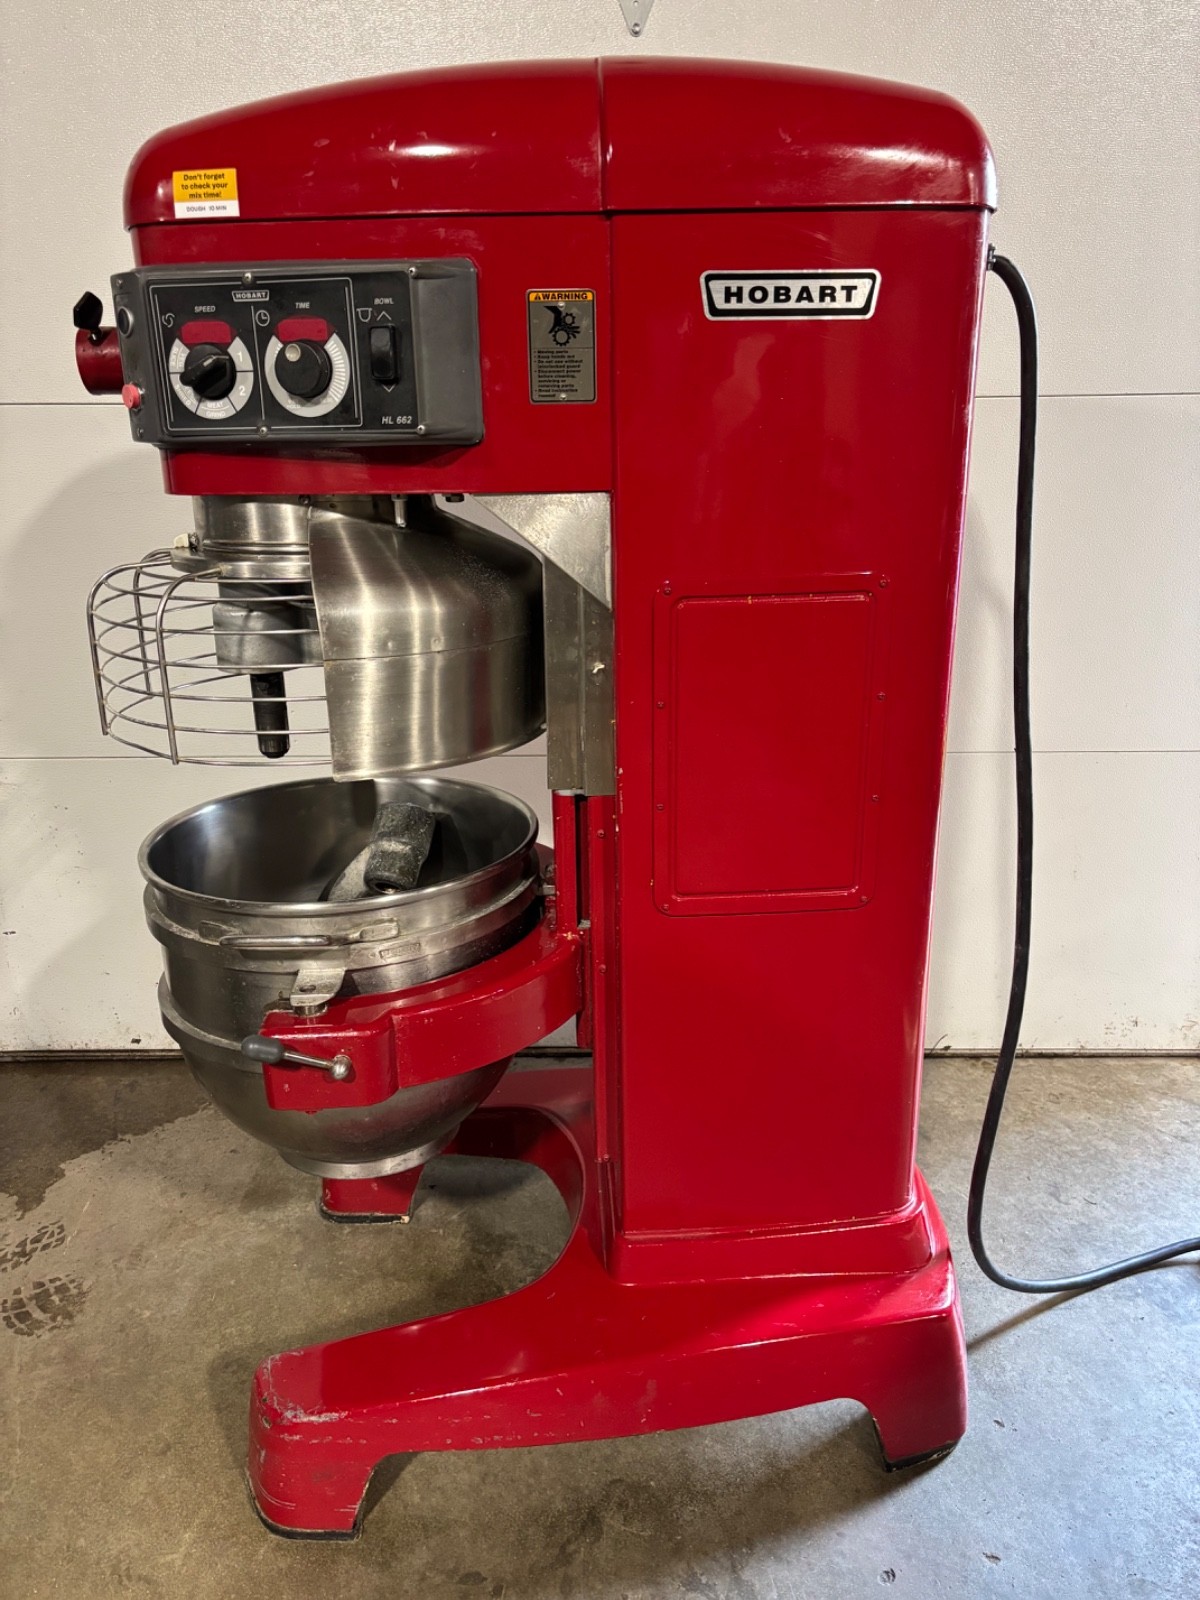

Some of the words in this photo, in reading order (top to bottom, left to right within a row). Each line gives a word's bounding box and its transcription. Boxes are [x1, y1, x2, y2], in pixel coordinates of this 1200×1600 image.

[183, 173, 203, 181] Don't
[203, 172, 225, 181] forget
[190, 182, 210, 190] check
[212, 182, 228, 190] your
[203, 191, 222, 199] time!
[541, 292, 588, 300] WARNING
[724, 285, 858, 304] HOBART
[373, 297, 394, 305] BOWL
[194, 305, 216, 313] SPEED
[237, 351, 243, 362] 1
[239, 385, 246, 396] 2
[381, 415, 395, 425] HL
[396, 415, 413, 425] 662
